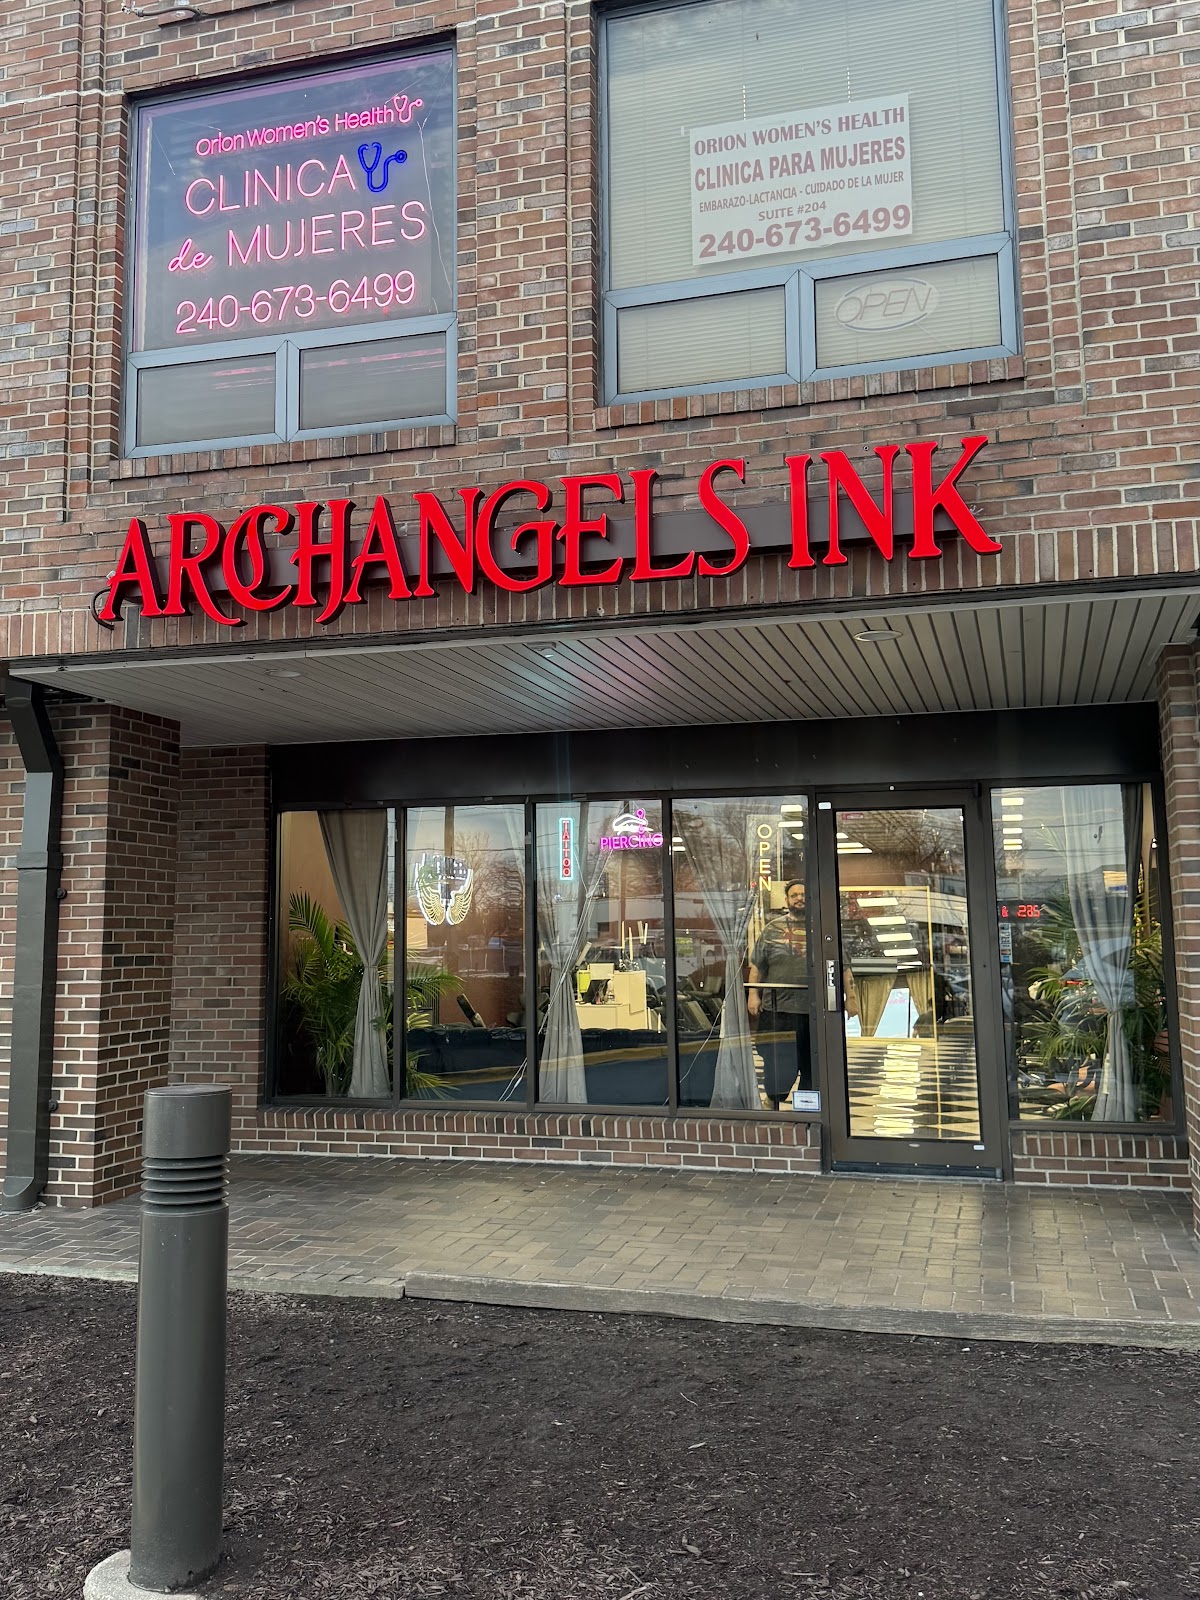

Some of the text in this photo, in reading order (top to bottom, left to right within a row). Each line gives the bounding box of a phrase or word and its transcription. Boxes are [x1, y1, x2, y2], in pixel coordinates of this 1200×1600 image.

[196, 105, 395, 157] Orion Women's Health
[694, 106, 905, 156] ORION WOMEN'S HEALTH
[185, 154, 356, 215] CLINICA
[694, 136, 905, 191] CLINICA PARA MUJERES
[699, 187, 797, 213] EMBARAZO-LACTANCIA
[805, 179, 845, 195] CUIDADO
[848, 176, 859, 188] DE
[861, 175, 872, 187] LA
[874, 171, 904, 186] MUJER
[758, 201, 827, 221] SUITE #204
[168, 200, 427, 272] de MUJERES
[699, 204, 911, 258] 240-673-6499
[175, 270, 415, 334] 240-673-6499
[835, 287, 932, 323] OPEN
[98, 435, 1003, 625] ARCHANGELS INK
[562, 820, 571, 877] TATTOO
[600, 832, 664, 850] PIERCING
[757, 823, 772, 892] OPEN
